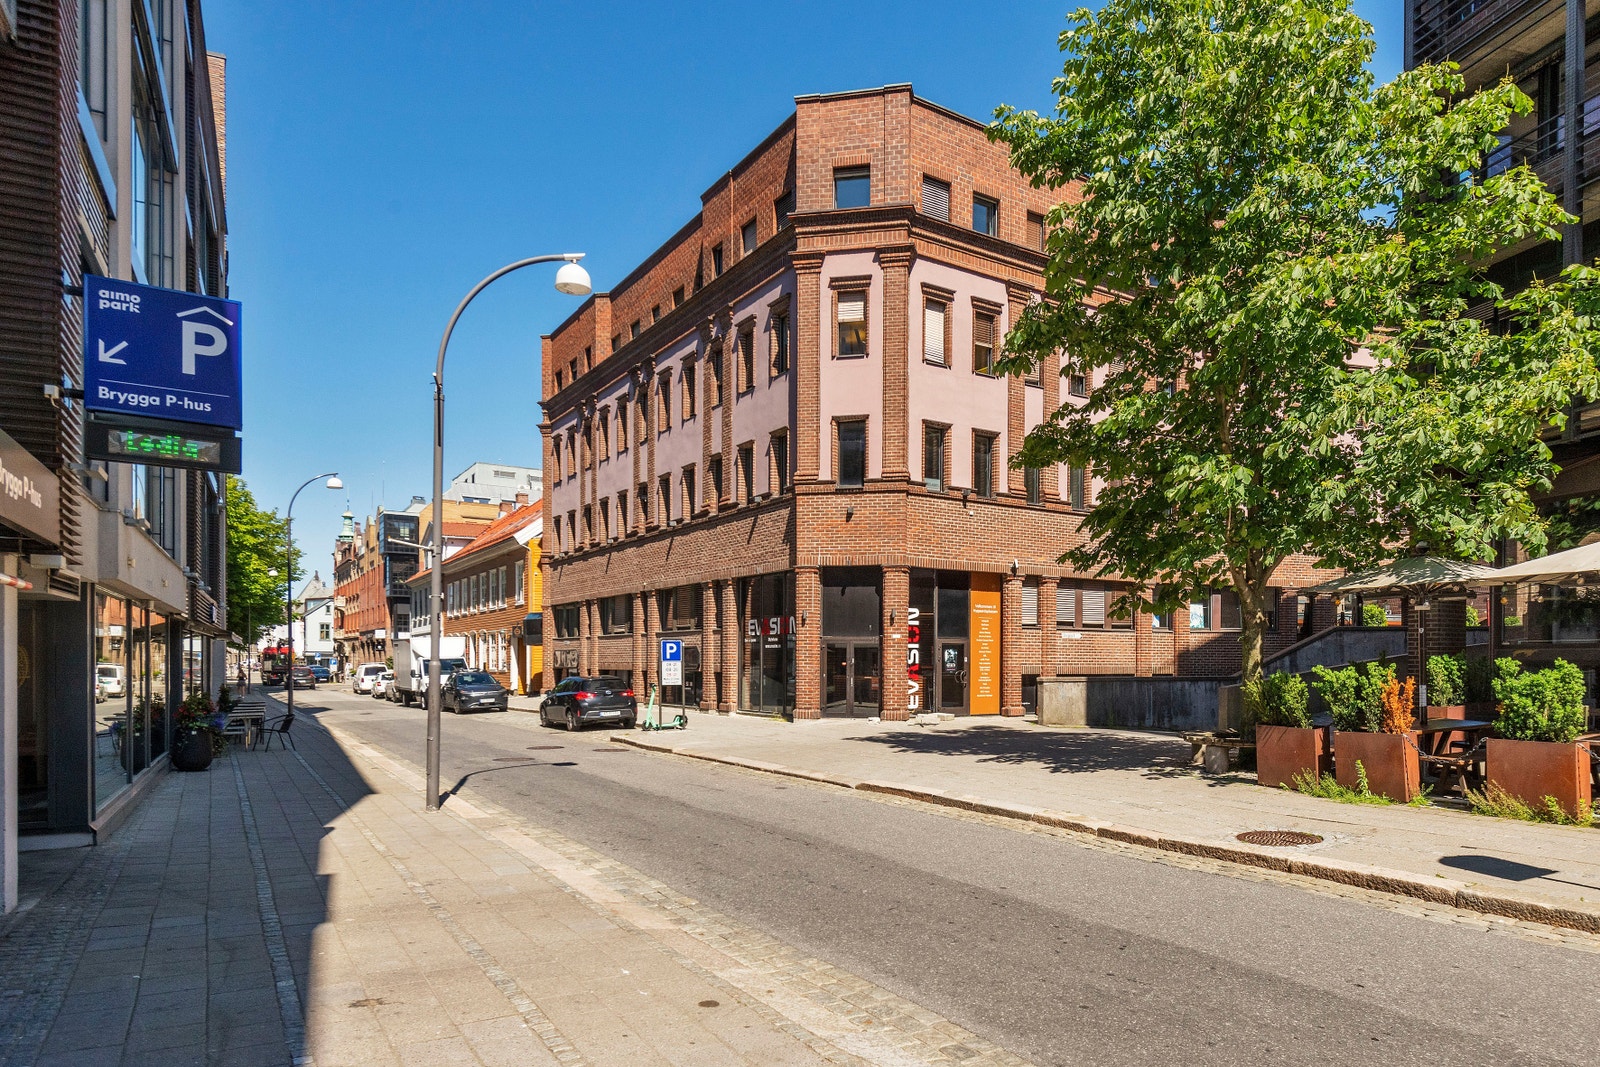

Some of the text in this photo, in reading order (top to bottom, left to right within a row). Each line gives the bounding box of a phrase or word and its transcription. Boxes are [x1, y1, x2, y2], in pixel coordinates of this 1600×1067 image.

[98, 289, 141, 303] aimo
[98, 299, 141, 314] park
[182, 320, 228, 375] P
[98, 386, 212, 412] Brygga P-hus
[0, 456, 23, 500] rygga
[666, 642, 678, 659] P
[907, 607, 920, 709] EVASION
